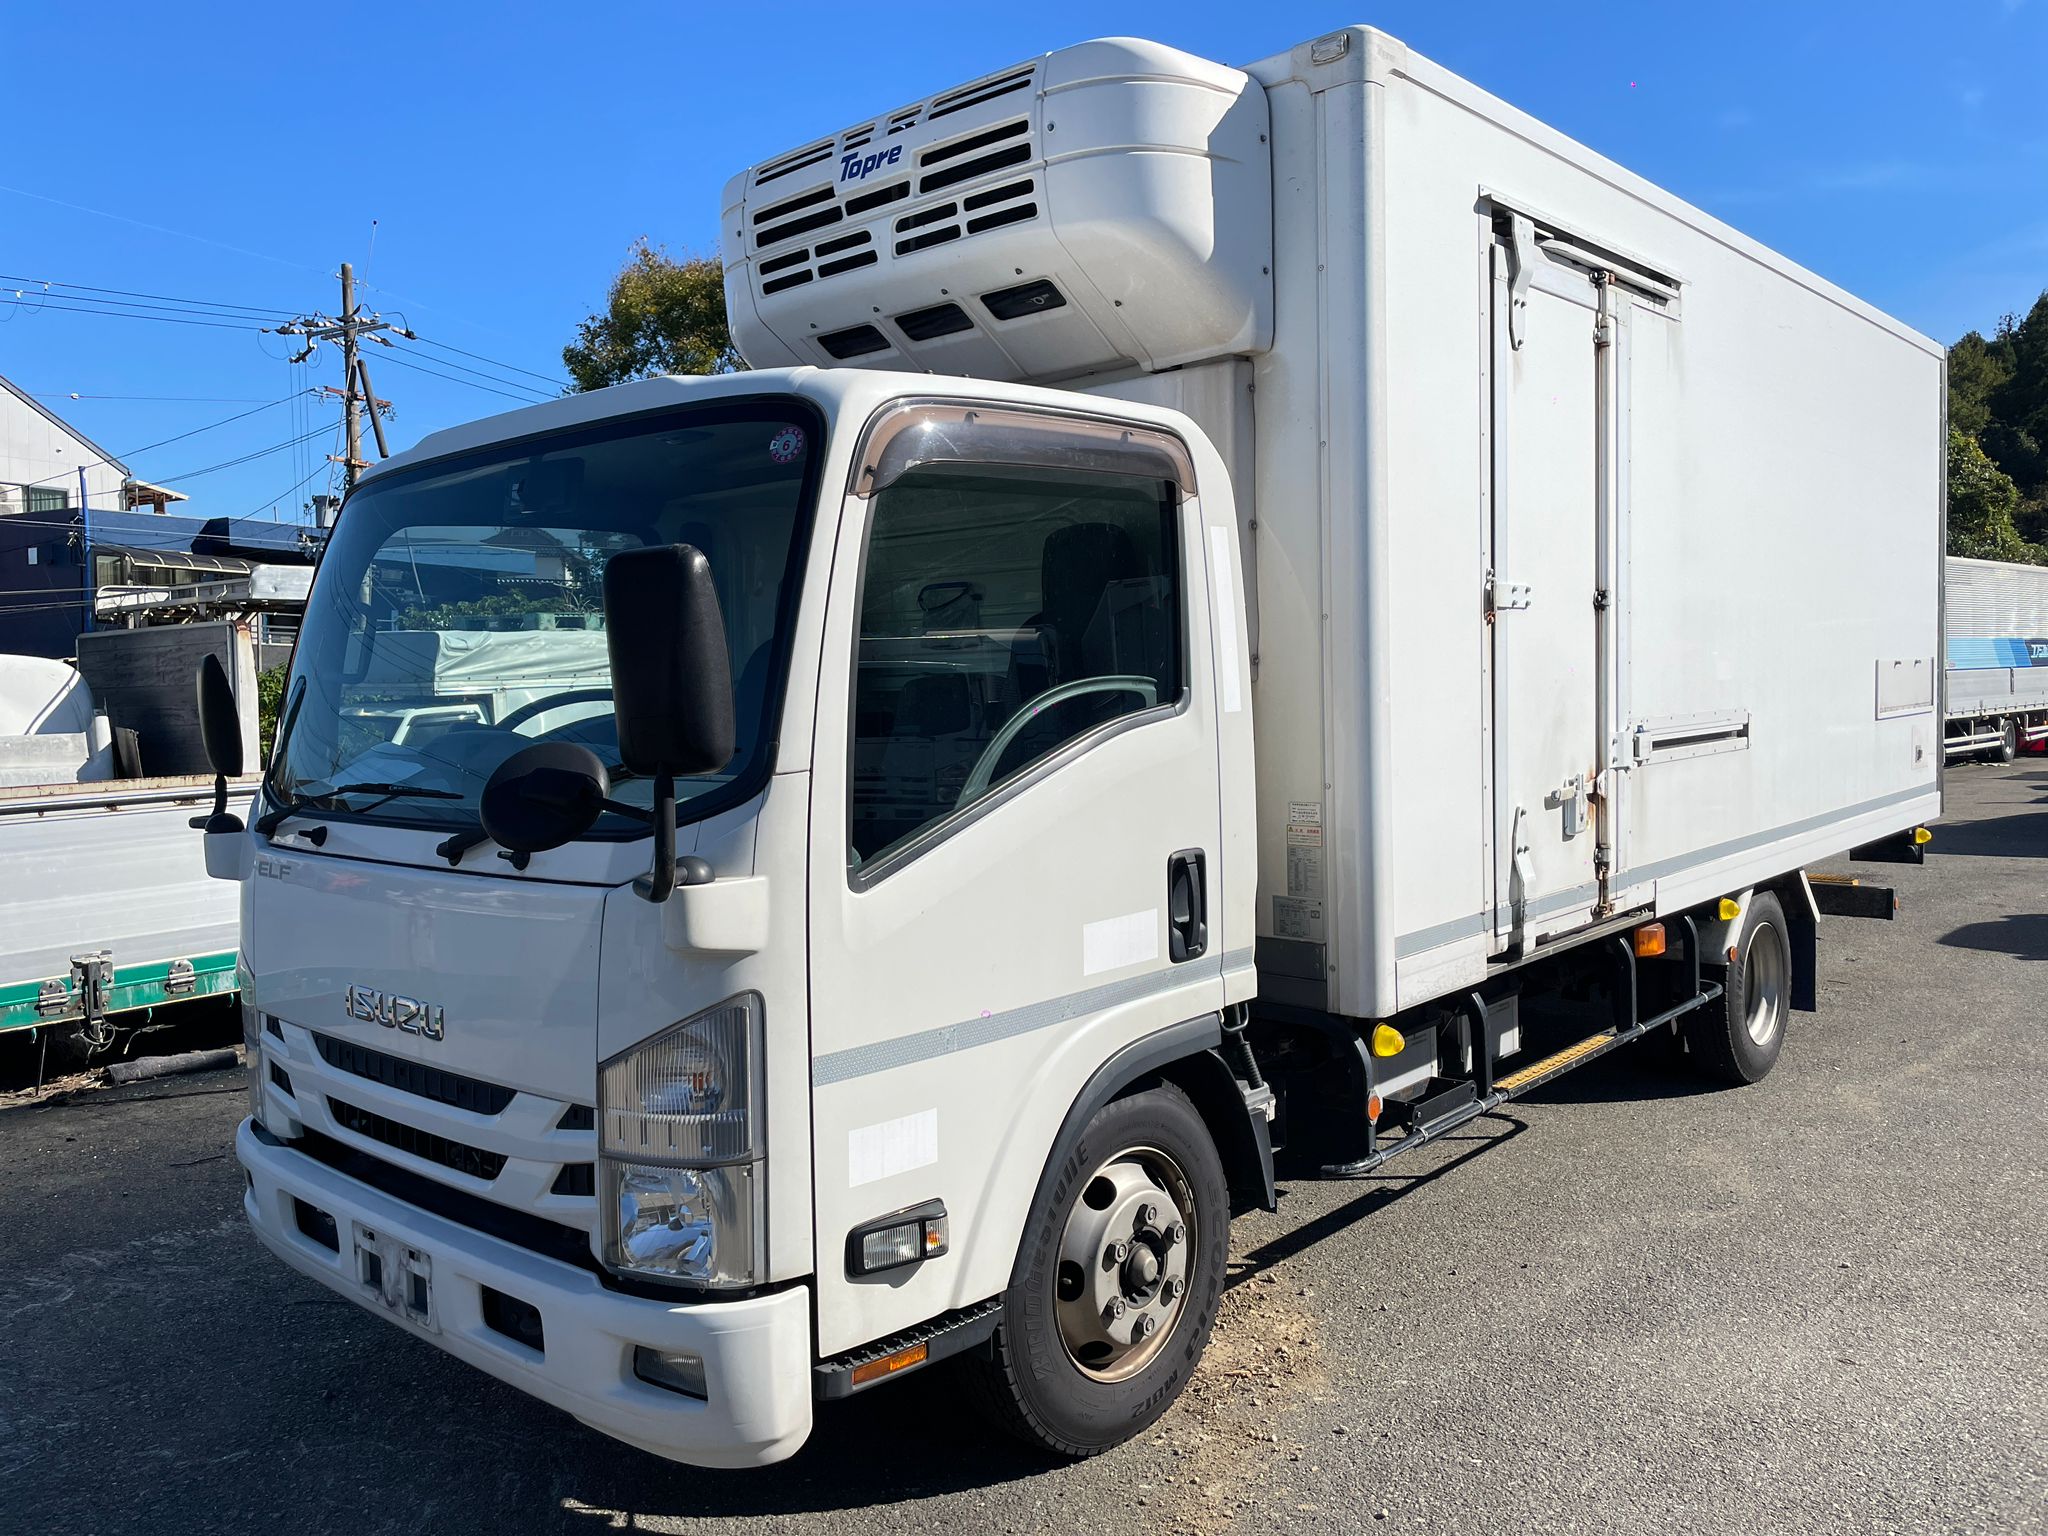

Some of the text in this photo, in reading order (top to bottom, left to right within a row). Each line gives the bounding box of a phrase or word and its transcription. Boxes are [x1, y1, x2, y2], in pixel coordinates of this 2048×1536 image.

[840, 144, 903, 182] Topre
[258, 861, 291, 880] ELF
[345, 982, 444, 1042] ISUZU
